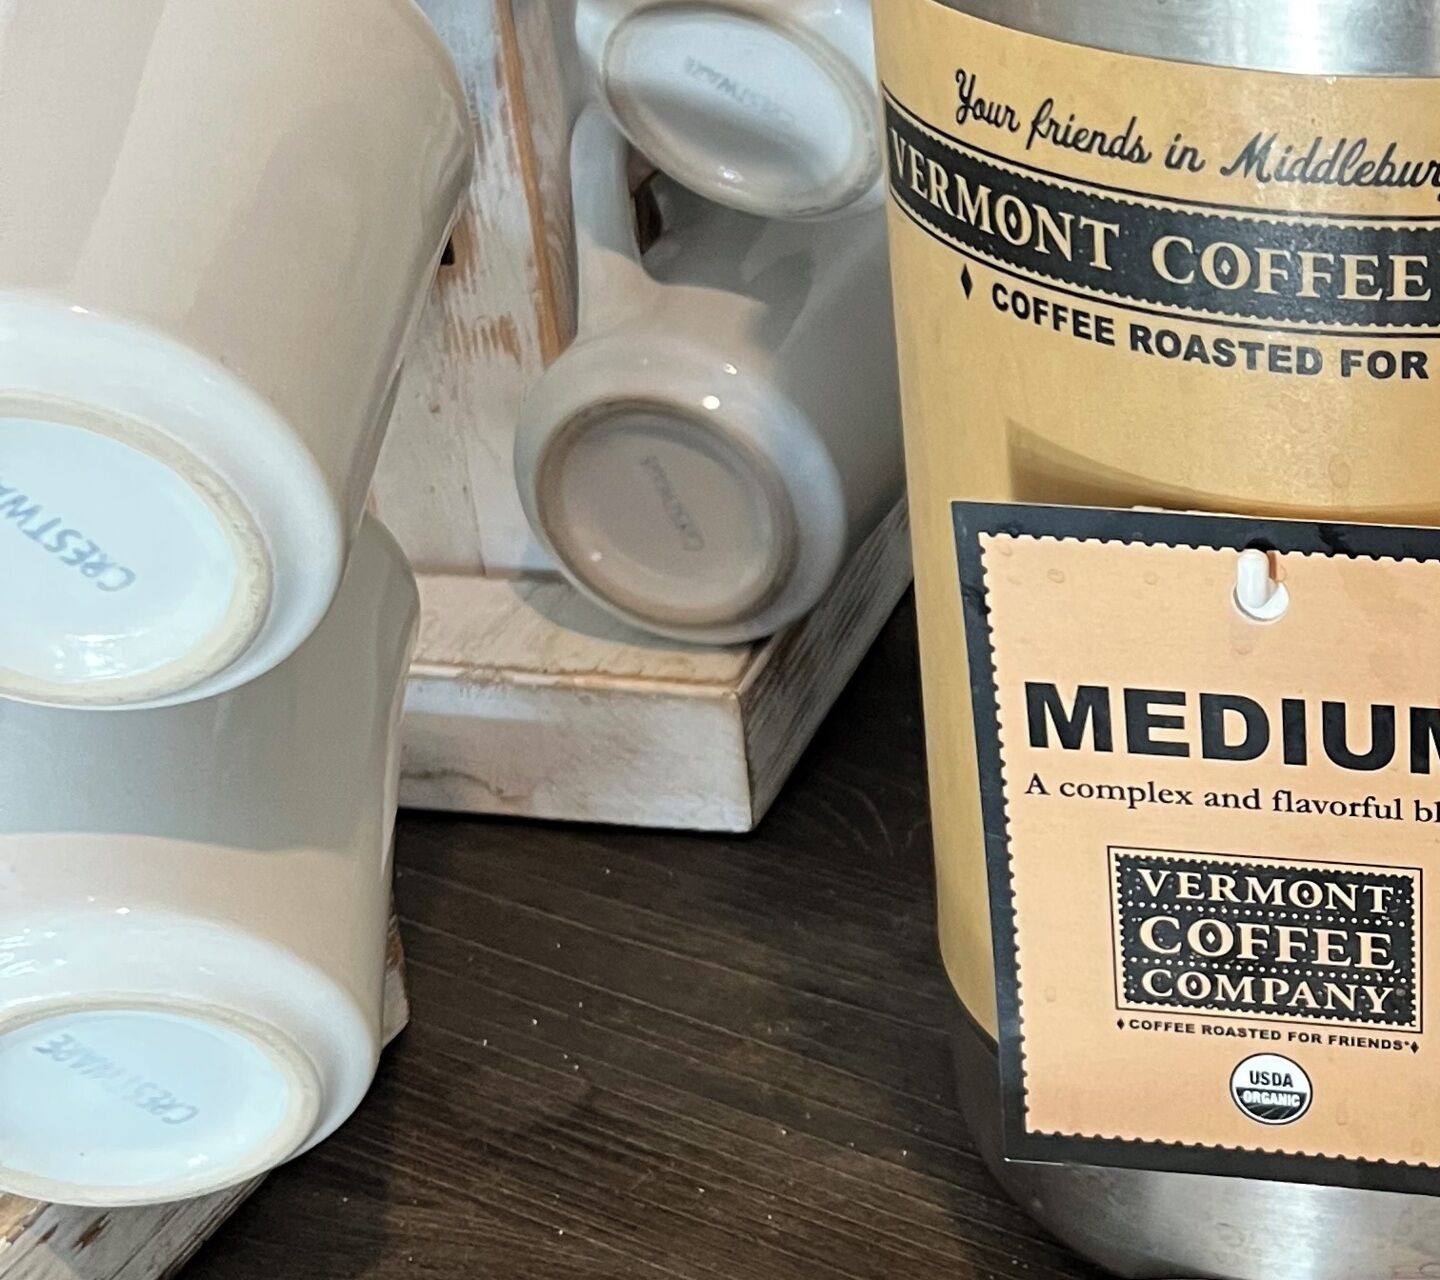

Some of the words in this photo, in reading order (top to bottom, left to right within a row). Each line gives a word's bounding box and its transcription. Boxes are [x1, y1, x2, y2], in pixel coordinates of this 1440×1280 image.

[953, 68, 1020, 133] Your
[1025, 98, 1153, 164] friends
[1164, 133, 1206, 172] in
[889, 127, 1120, 271] VERMONT
[1151, 235, 1432, 302] COFFEE
[992, 282, 1115, 347] COFFEE
[1130, 323, 1323, 376] ROASTED
[1341, 348, 1429, 379] FOR
[1025, 772, 1051, 797] A
[1059, 779, 1194, 811] complex
[1203, 786, 1261, 813] and
[1272, 790, 1405, 821] flavorful
[1137, 867, 1396, 916] VERMONT
[1139, 915, 1396, 971] COFFEE
[1141, 969, 1394, 1015] COMPANY
[1129, 1019, 1195, 1034] COFFEE
[1201, 1024, 1282, 1041] ROASTED
[1288, 1030, 1323, 1045] FOR
[1242, 1089, 1301, 1108] ORGANIC
[1249, 1069, 1294, 1089] USDA
